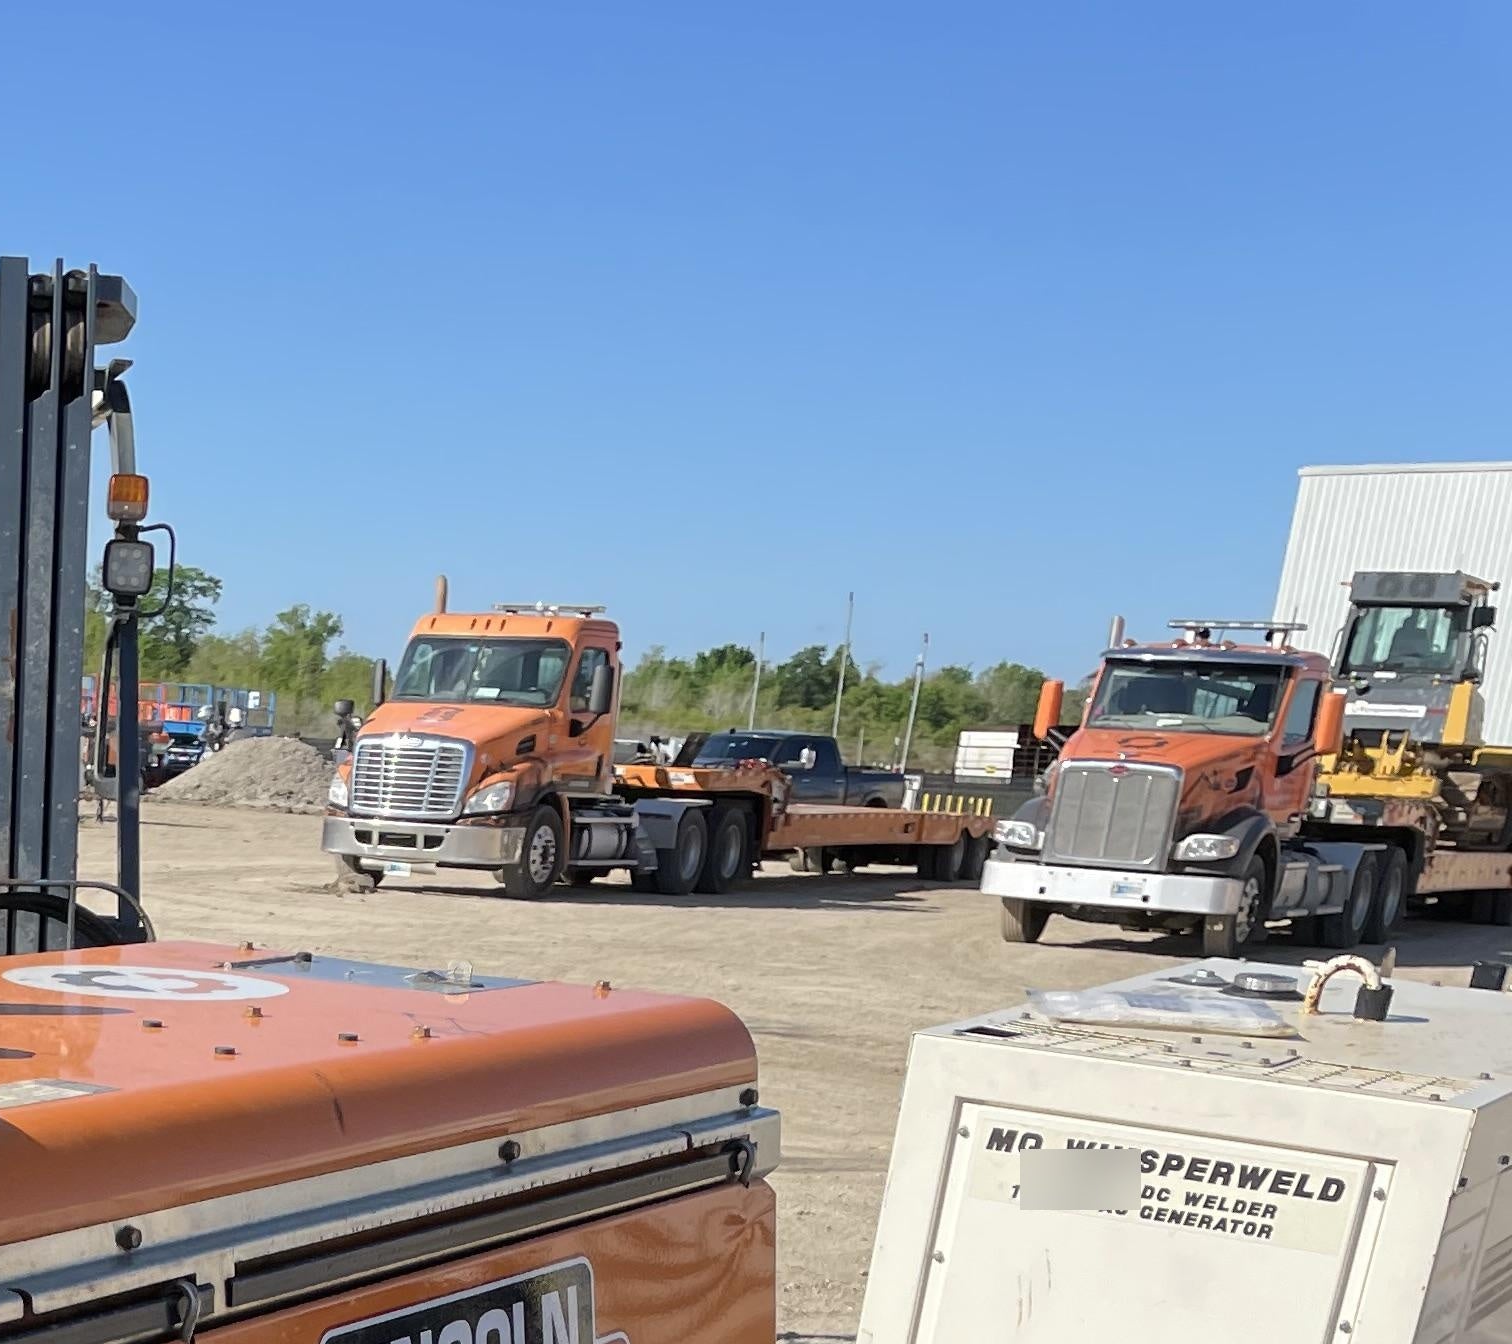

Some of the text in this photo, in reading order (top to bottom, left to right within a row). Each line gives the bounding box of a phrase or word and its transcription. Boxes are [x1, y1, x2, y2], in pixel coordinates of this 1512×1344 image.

[1065, 1138, 1346, 1204] SPERWELD
[1140, 1184, 1278, 1219] DC WELDER
[1139, 1204, 1274, 1240] GENERATOR
